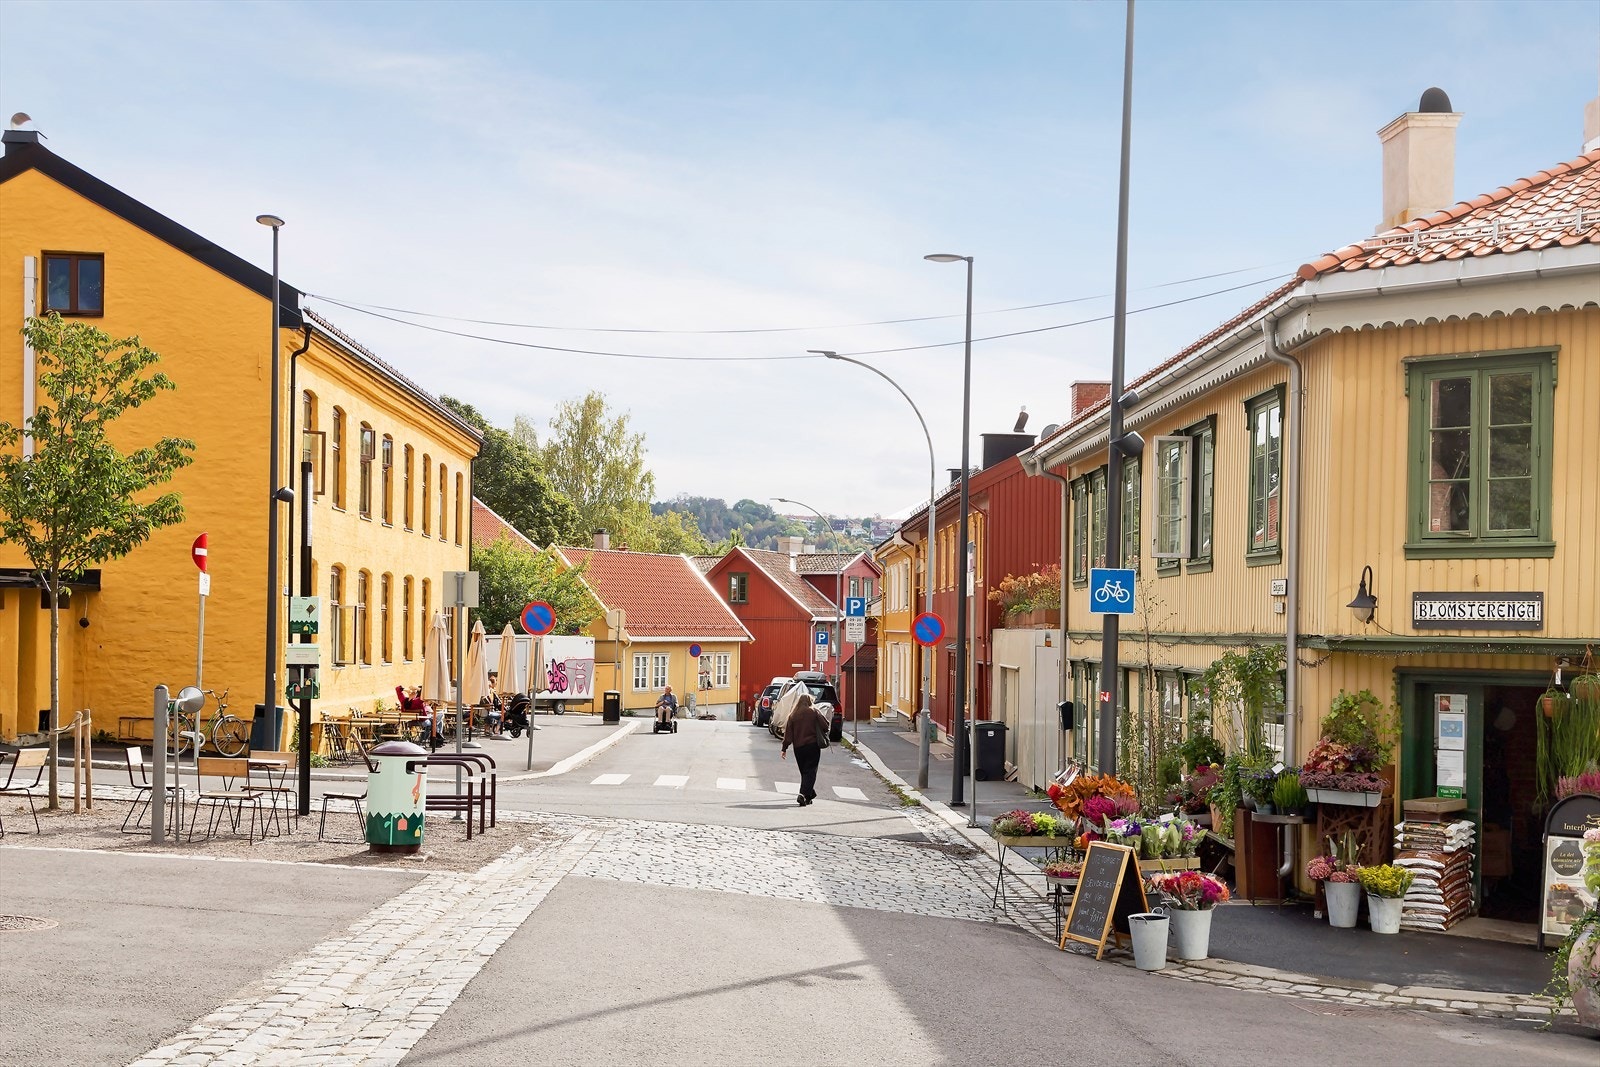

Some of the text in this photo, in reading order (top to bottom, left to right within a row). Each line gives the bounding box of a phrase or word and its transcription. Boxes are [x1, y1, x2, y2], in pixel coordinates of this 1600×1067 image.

[850, 599, 861, 615] P
[1419, 603, 1536, 618] BLOMSTERENGA
[818, 634, 826, 644] P
